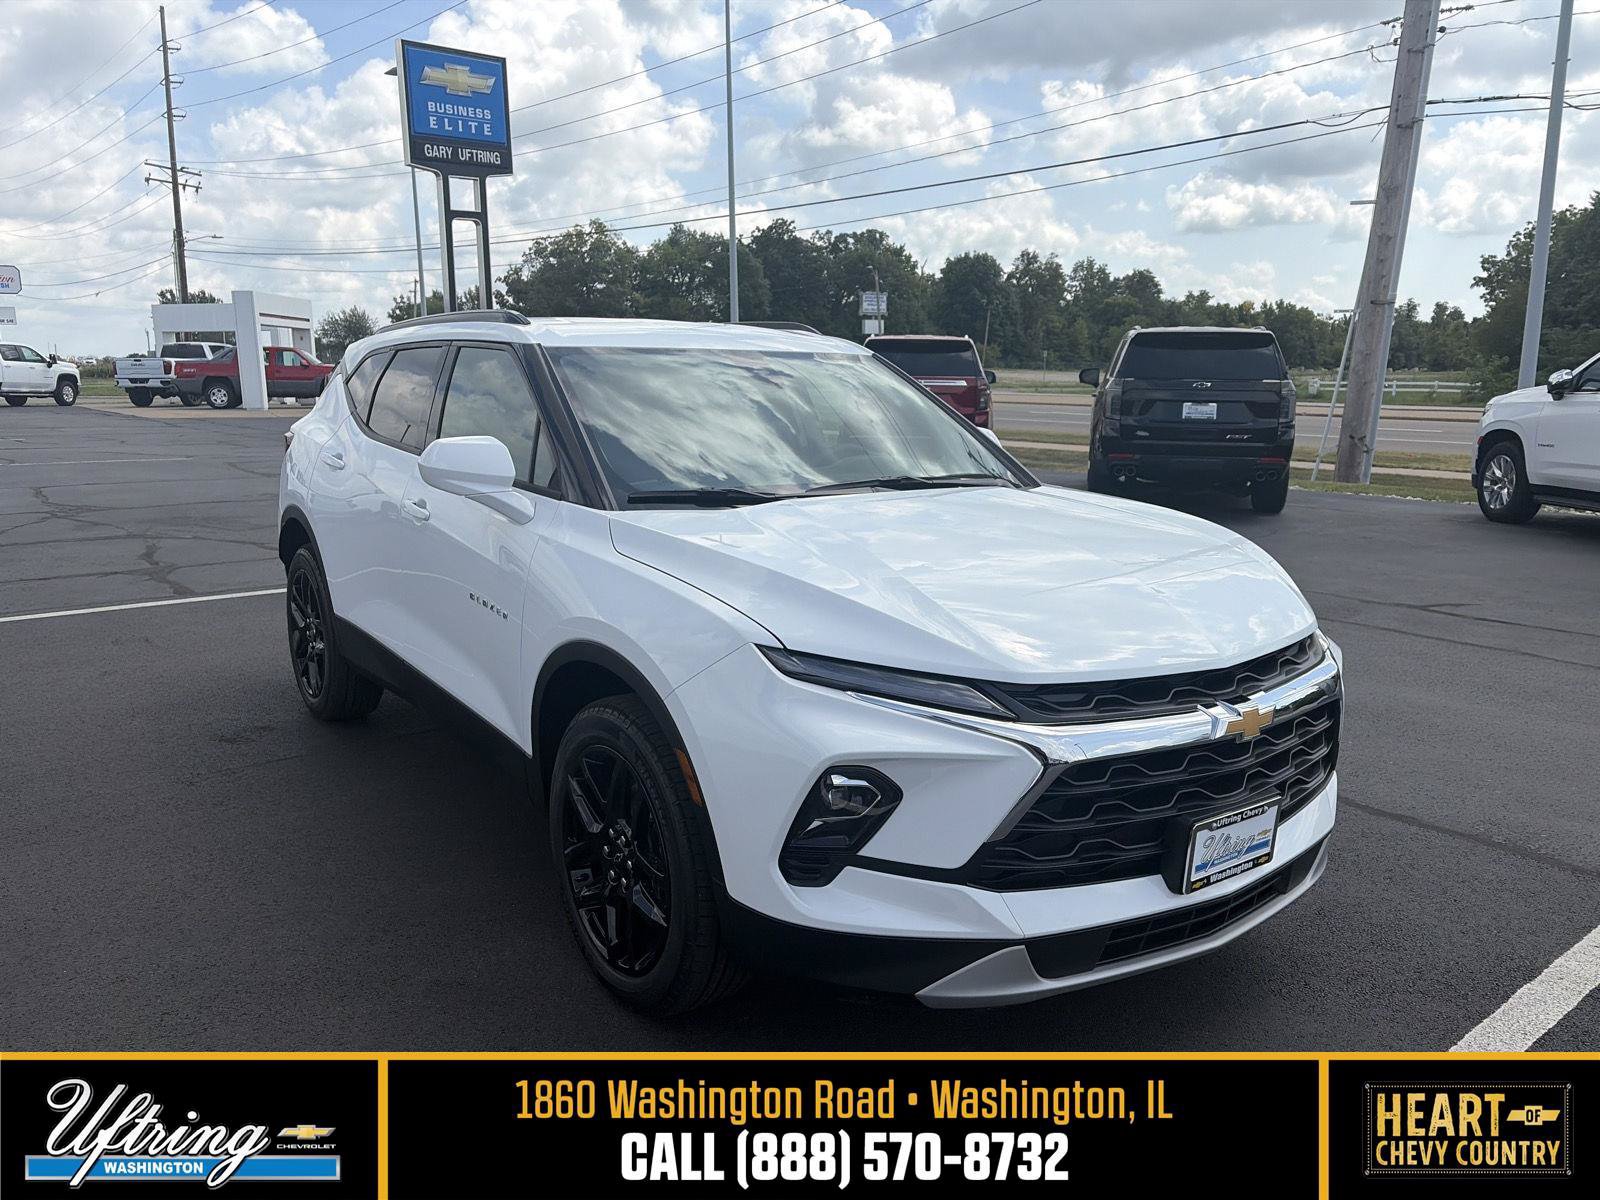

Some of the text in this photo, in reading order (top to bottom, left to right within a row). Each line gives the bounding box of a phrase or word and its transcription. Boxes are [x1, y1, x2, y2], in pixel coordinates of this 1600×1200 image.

[427, 101, 492, 120] BUSINESS
[429, 116, 492, 136] ELITE
[424, 144, 501, 165] GARY UFTRING
[1217, 807, 1263, 827] Uftring Chevy
[1210, 860, 1253, 883] Washington
